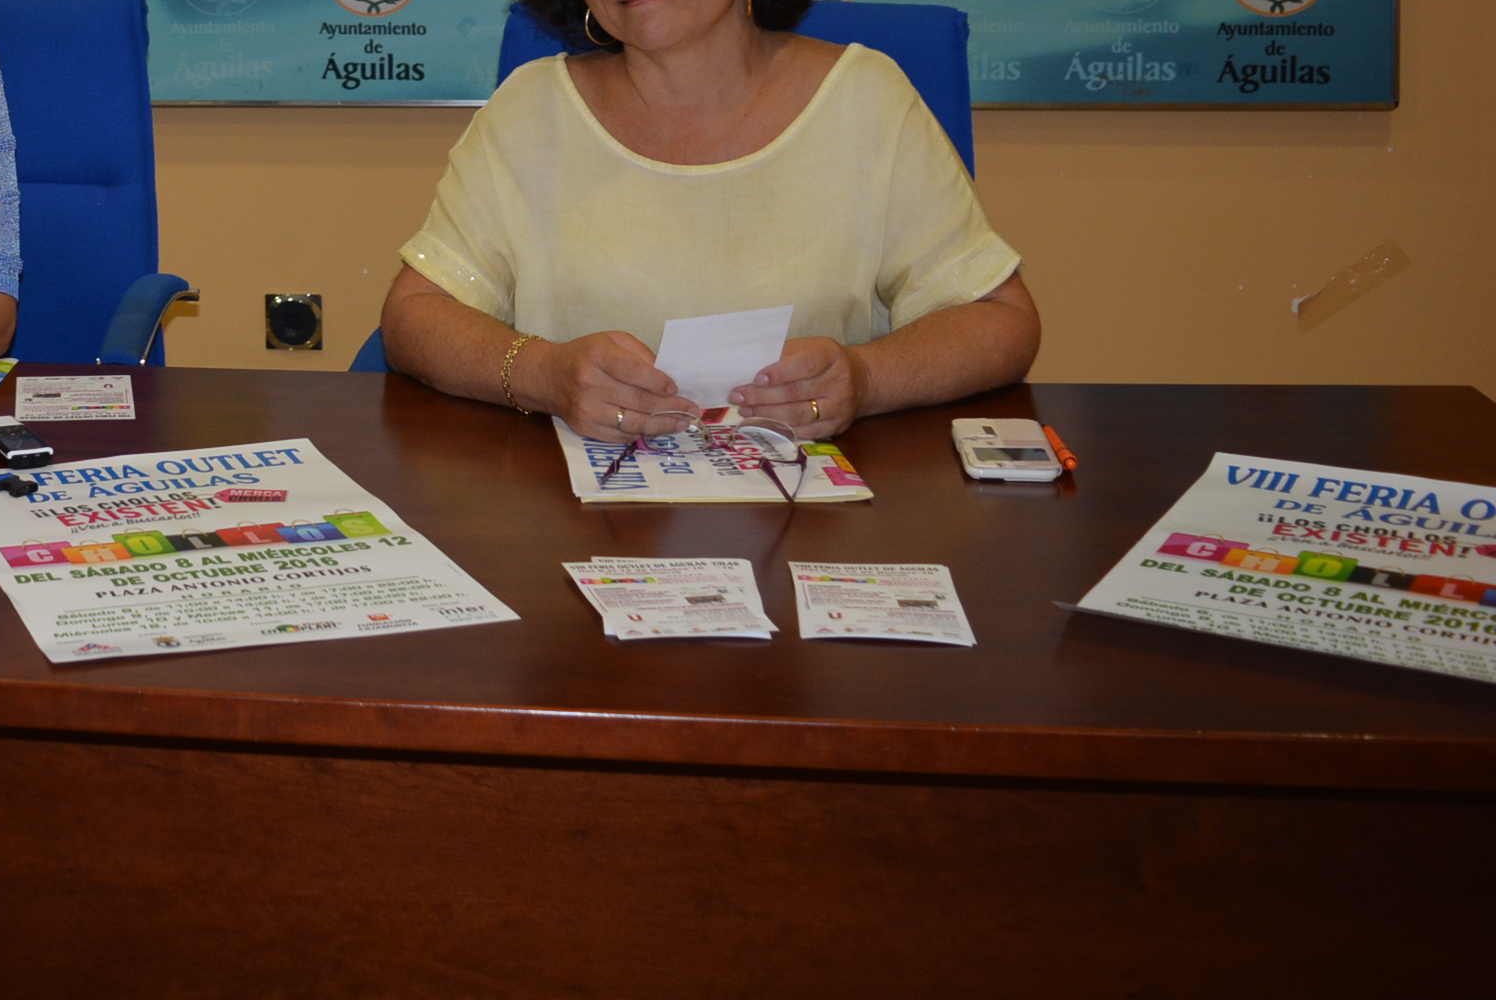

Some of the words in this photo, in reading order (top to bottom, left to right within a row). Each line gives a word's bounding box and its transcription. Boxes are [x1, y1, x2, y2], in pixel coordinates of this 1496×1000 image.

[320, 22, 427, 39] Ayuntamiento
[1112, 37, 1132, 54] de
[1217, 22, 1334, 40] Ayuntamiento
[364, 39, 382, 54] de
[1265, 40, 1285, 56] de
[322, 53, 425, 90] Águilas
[1064, 52, 1176, 91] Águilas
[1217, 55, 1331, 93] Águilas
[31, 462, 152, 487] FERIA
[157, 448, 305, 483] OUTLET
[26, 491, 73, 503] DE
[85, 472, 260, 499] ÁGUILAS
[229, 489, 283, 499] MERCA
[1227, 466, 1299, 493] VIII
[1310, 477, 1441, 515] FERIA
[1140, 559, 1195, 573] DEL
[1201, 566, 1312, 592] SÁBADO
